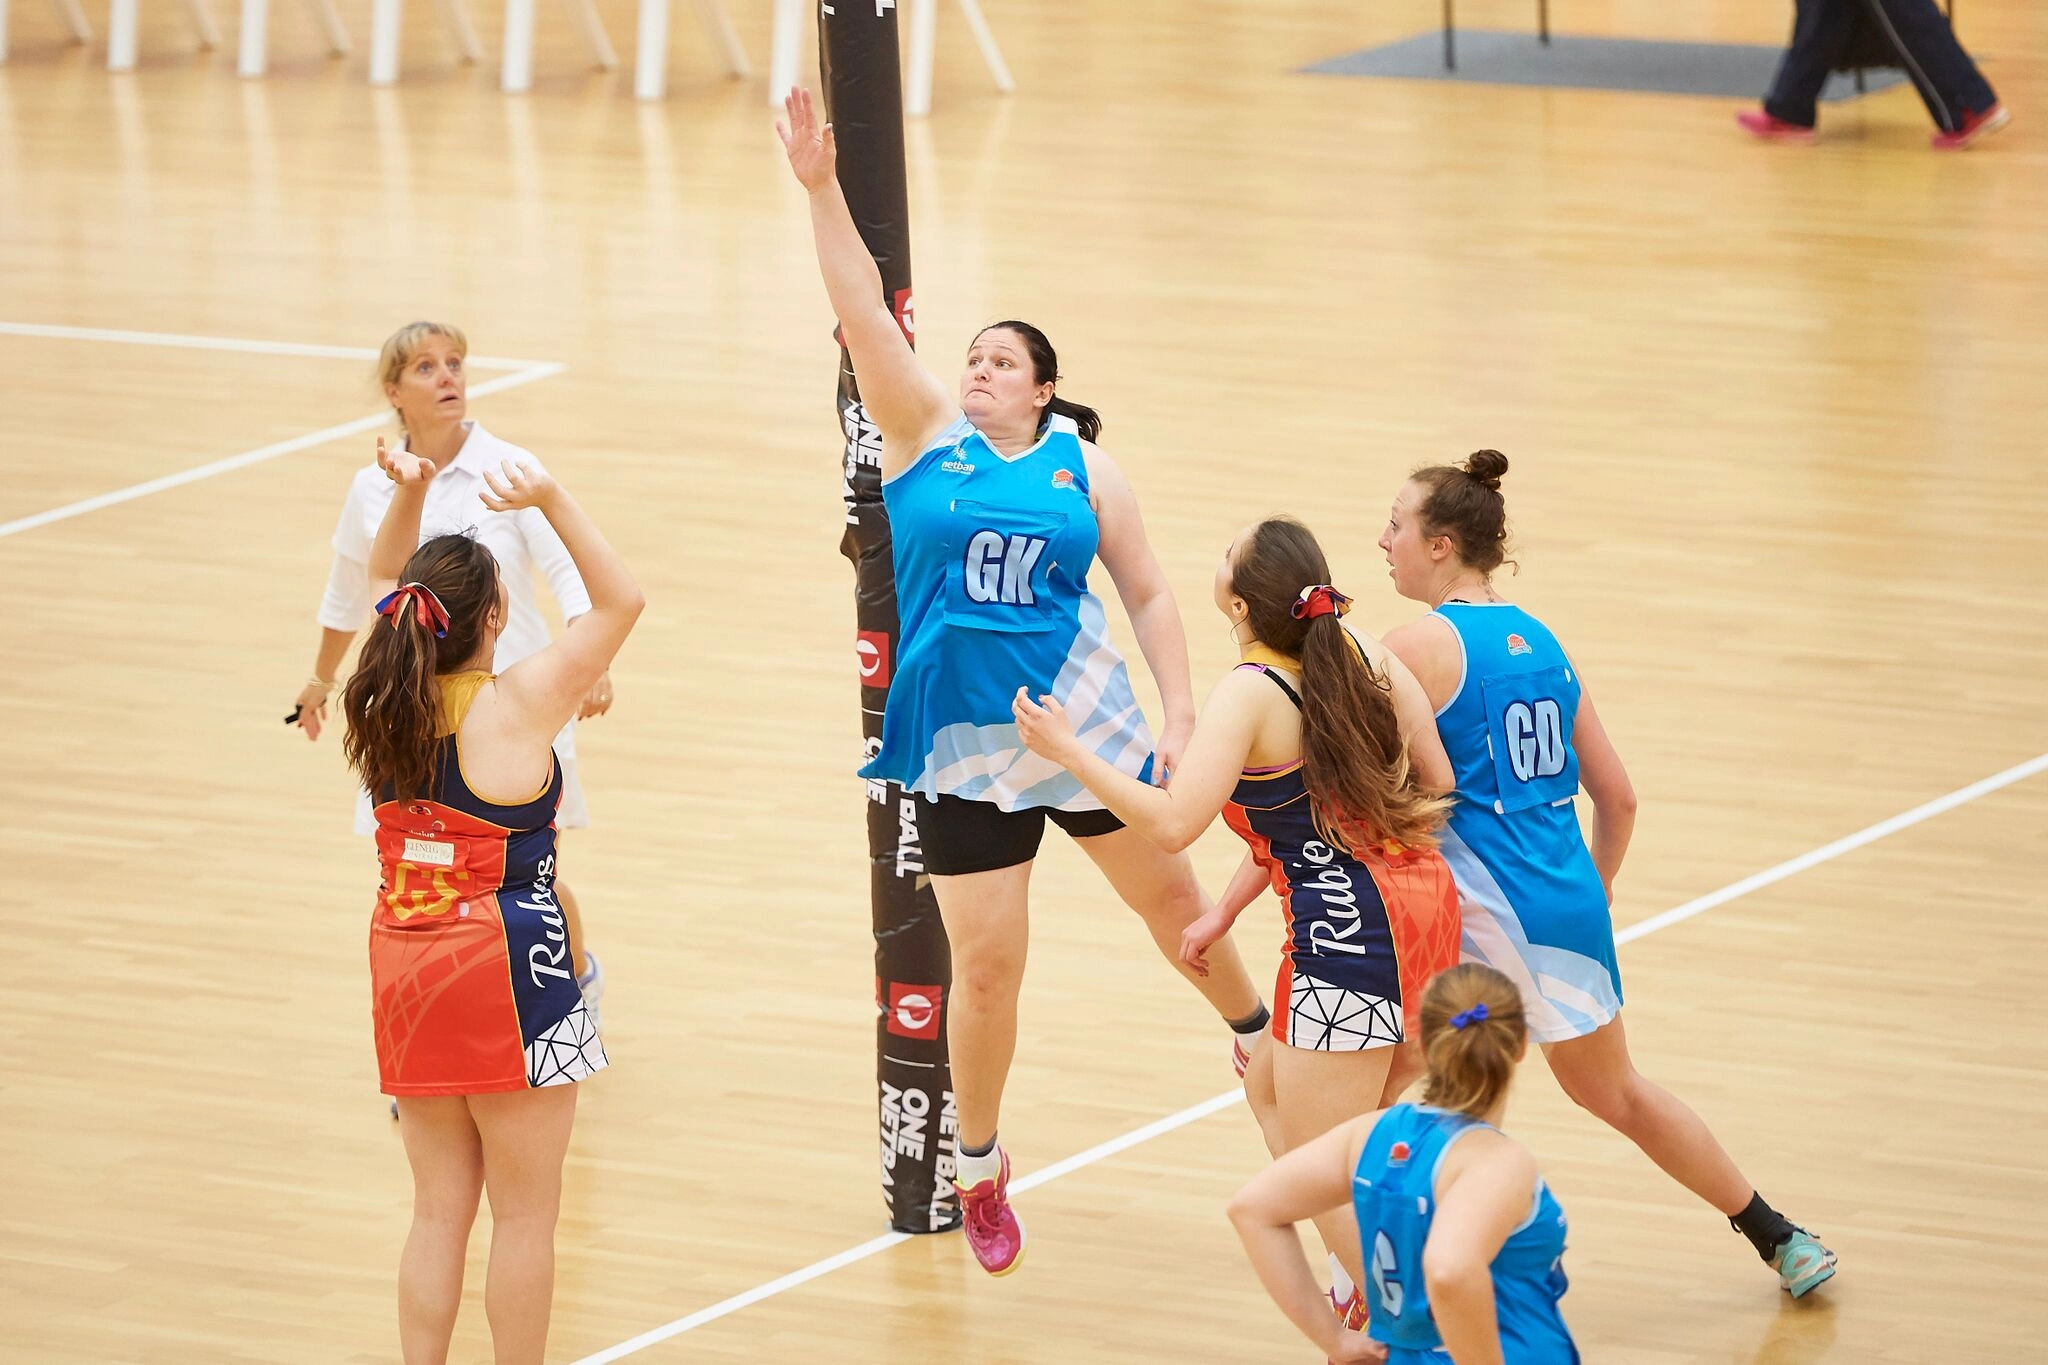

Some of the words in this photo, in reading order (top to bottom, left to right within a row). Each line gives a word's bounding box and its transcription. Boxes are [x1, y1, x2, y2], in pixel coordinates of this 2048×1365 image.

[941, 461, 975, 473] netball
[964, 528, 1050, 607] GK
[1503, 697, 1566, 783] GD
[387, 862, 469, 921] GS
[881, 1080, 902, 1219] NETBAL
[897, 1087, 930, 1162] ONE
